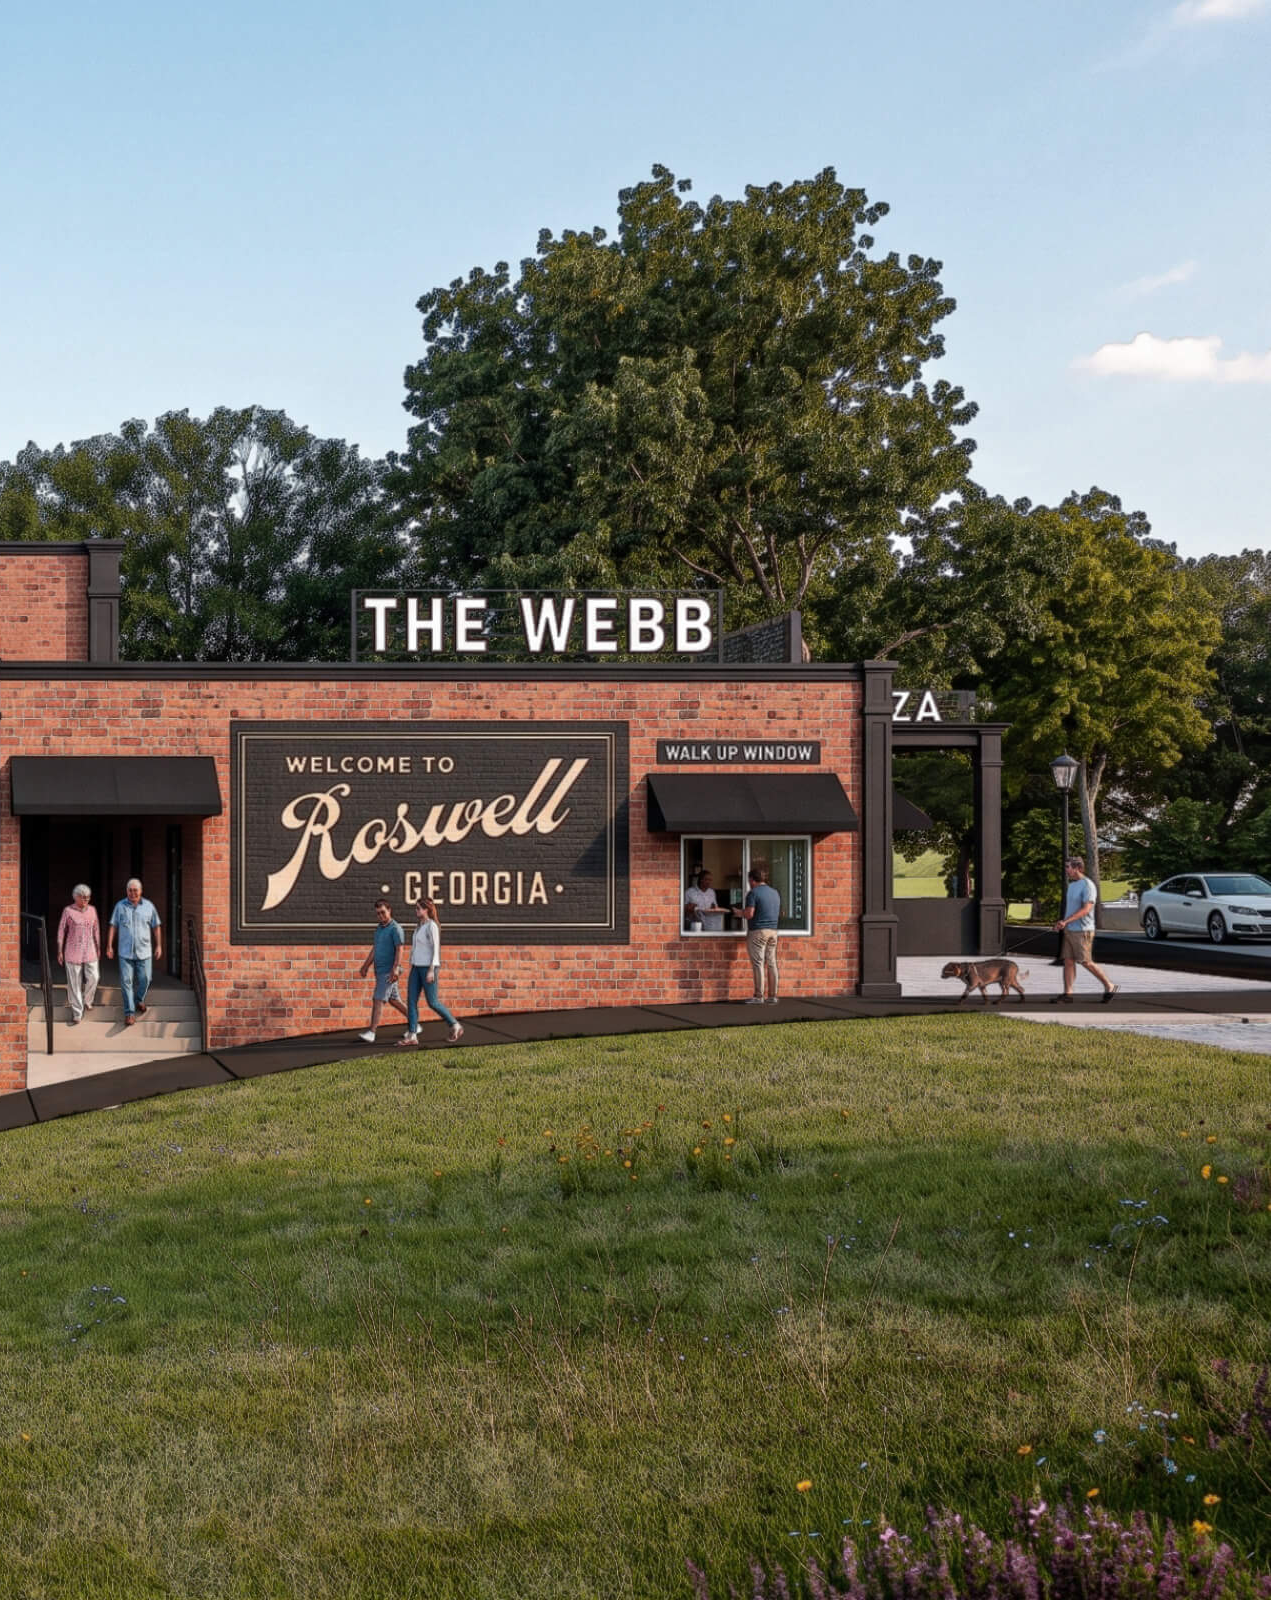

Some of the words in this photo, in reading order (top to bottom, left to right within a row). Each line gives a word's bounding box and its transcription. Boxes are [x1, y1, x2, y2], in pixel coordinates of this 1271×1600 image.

[364, 598, 488, 652] THE
[520, 598, 713, 652] WEBB
[286, 756, 411, 773] WELCOME
[422, 756, 455, 773] TO
[665, 745, 712, 761] WALK
[716, 745, 738, 761] UP
[743, 745, 813, 761] WINDOW
[261, 758, 590, 911] Roswell
[404, 871, 549, 905] GEORGIA
